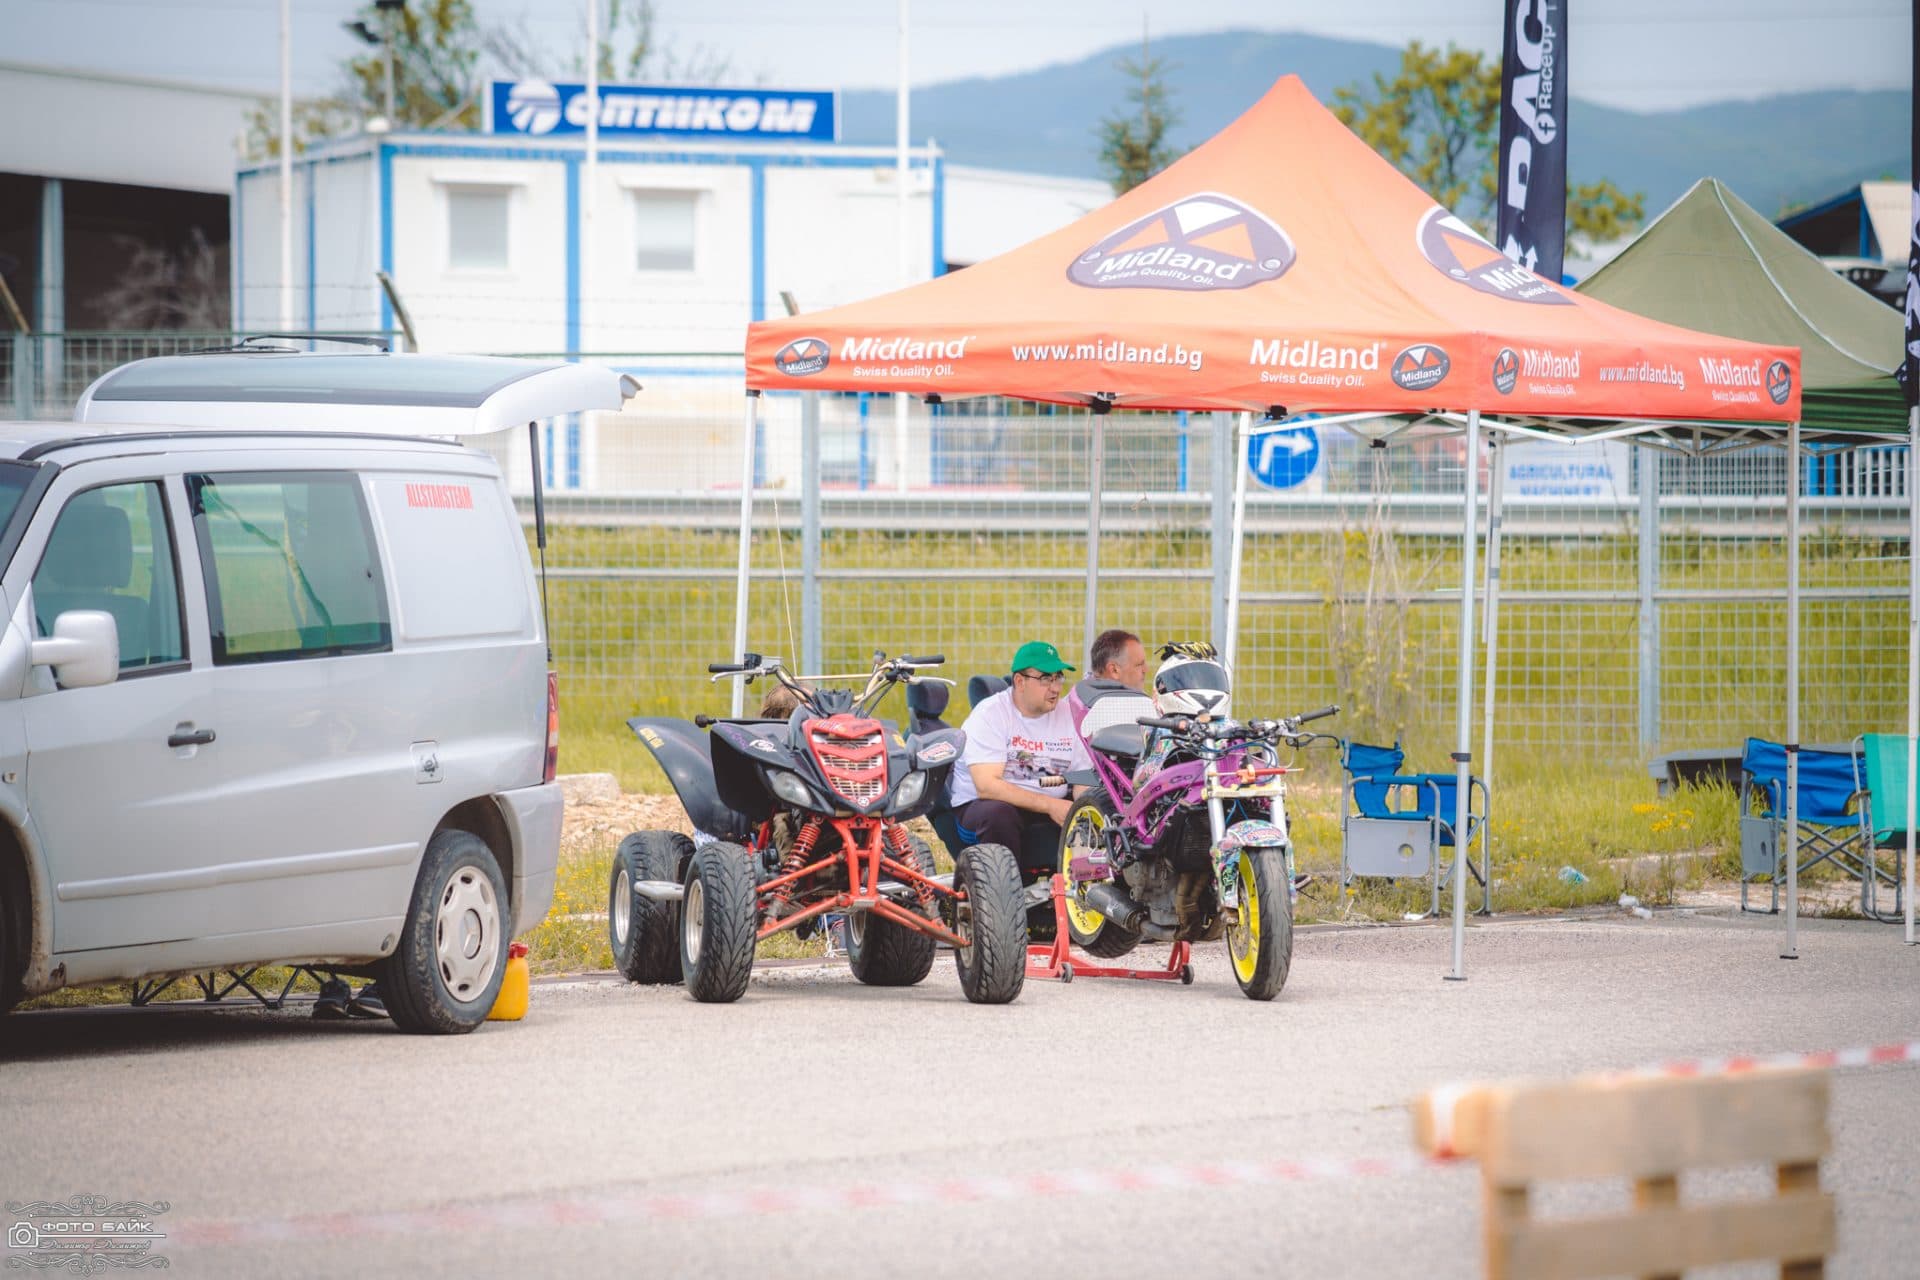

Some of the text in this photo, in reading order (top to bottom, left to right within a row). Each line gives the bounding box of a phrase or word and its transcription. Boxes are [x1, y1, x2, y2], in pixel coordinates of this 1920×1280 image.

[1094, 247, 1244, 280] Midland
[1140, 267, 1191, 283] Quality
[840, 336, 966, 361] Midland
[1012, 340, 1203, 370] www.midland.bg
[1250, 338, 1379, 370] Midland
[853, 364, 954, 380] Swiss Quality Oil.
[1401, 366, 1442, 383] Midland
[1522, 349, 1580, 378] Midland
[1600, 361, 1684, 390] www.midland.bg
[1699, 358, 1761, 386] Midland
[1260, 371, 1365, 388] Swiss Quality Oil.
